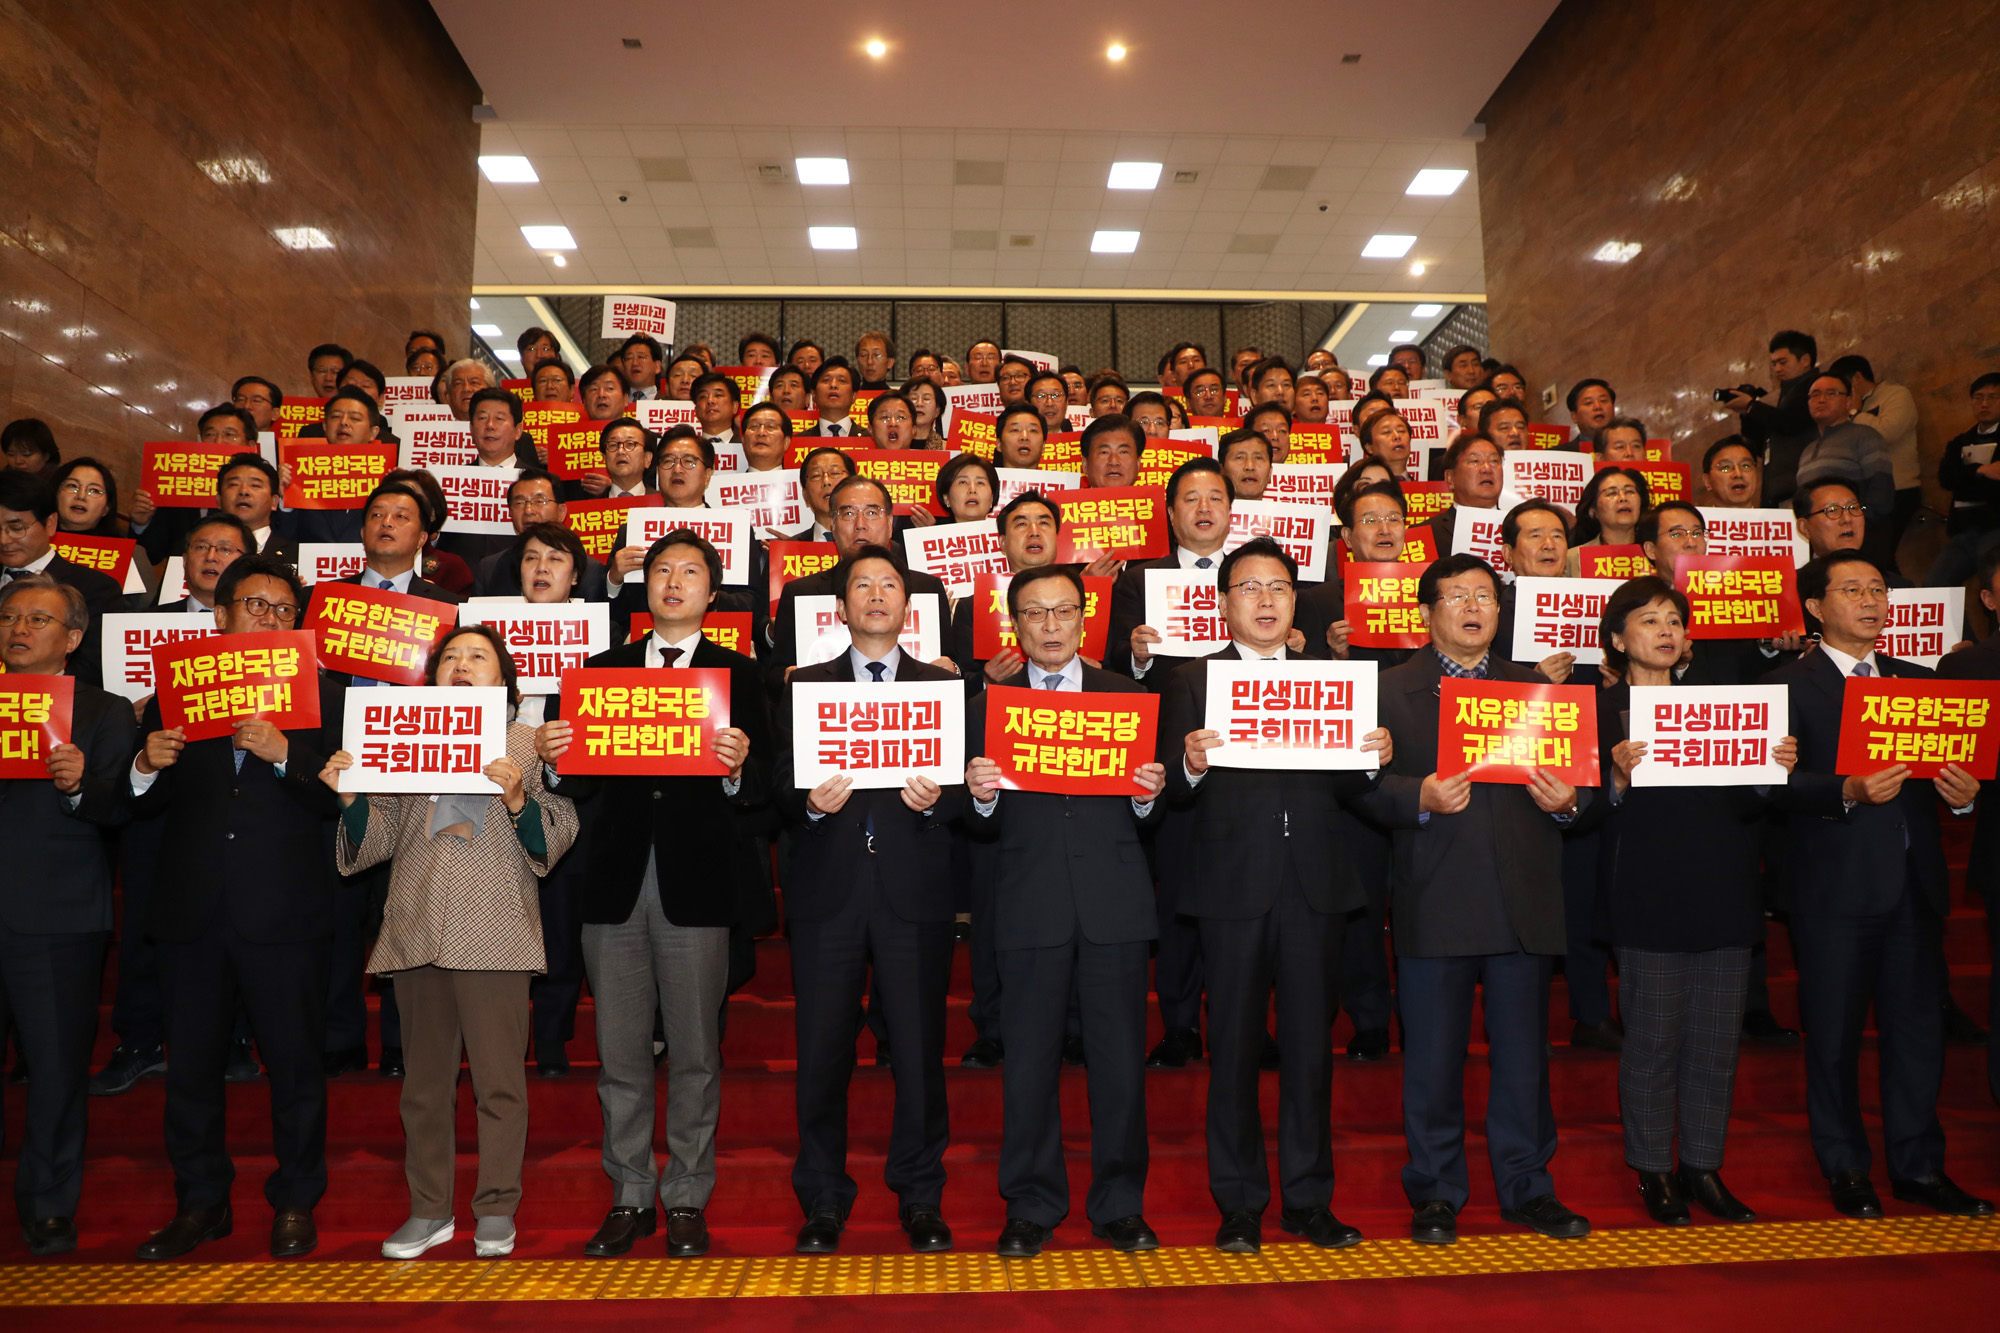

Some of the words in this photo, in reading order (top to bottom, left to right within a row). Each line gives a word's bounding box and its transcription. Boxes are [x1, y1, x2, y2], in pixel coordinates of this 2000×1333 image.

[613, 317, 665, 336] 국회파괴
[614, 303, 666, 319] 민생파괴
[297, 456, 385, 476] 자유한국당
[857, 461, 940, 481] 자유한국당
[1514, 462, 1583, 481] 민생파괴
[1061, 498, 1153, 524] 자유한국당
[1072, 525, 1147, 548] 규탄한다
[1708, 521, 1792, 541] 민생파괴
[1687, 570, 1782, 594] 자유한국당
[320, 597, 439, 641] 자유한국당
[1693, 600, 1779, 624] 규탄한다!
[323, 628, 420, 670] 규탄한다
[170, 648, 299, 689] 자유한국당
[182, 683, 292, 723] 규탄한다!
[578, 687, 713, 718] 자유한국당
[1232, 680, 1353, 711] 민생파괴
[365, 706, 482, 735] 민생파괴
[819, 701, 941, 732] 민생파괴
[1005, 707, 1140, 742] 자유한국당
[1456, 697, 1580, 731] 자유한국당
[1655, 703, 1768, 732] 민생파괴
[1861, 696, 1989, 727] 자유한국당
[586, 725, 701, 756] 규탄한다!
[1230, 718, 1353, 749] 국회파괴
[1868, 731, 1976, 762] 규탄한다!
[362, 743, 481, 773] 국회파괴
[818, 738, 941, 770] 국회파괴
[1013, 742, 1127, 777] 규탄한다!
[1463, 734, 1571, 767] 규탄한다!
[1654, 738, 1767, 767] 국회파괴
